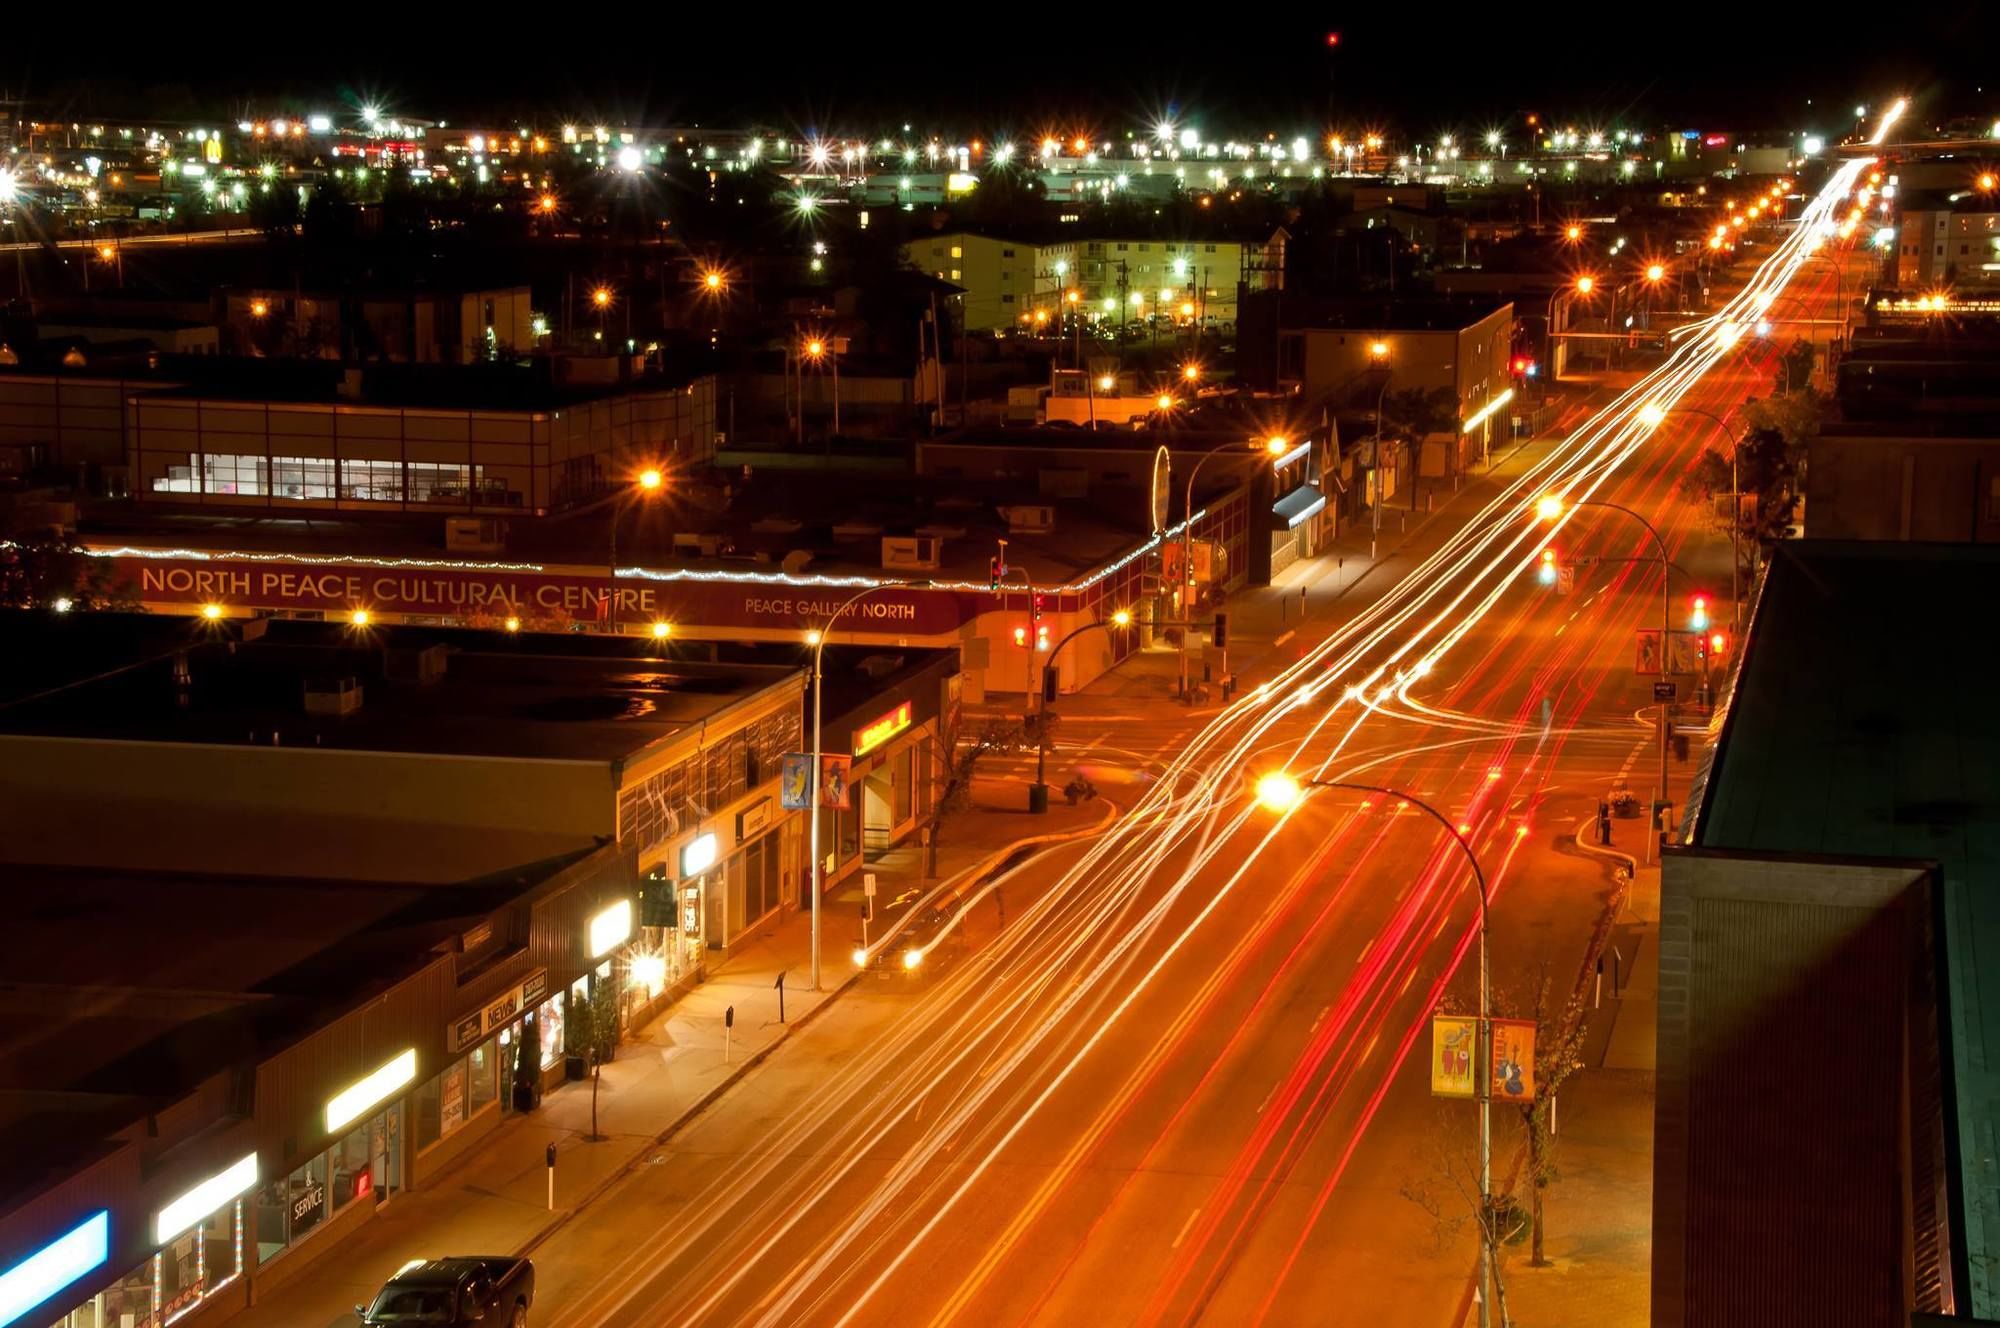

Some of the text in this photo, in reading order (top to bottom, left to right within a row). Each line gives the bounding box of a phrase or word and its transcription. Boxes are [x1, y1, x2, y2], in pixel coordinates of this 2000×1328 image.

[142, 567, 250, 595] NORTH
[262, 572, 361, 599] PEACE
[372, 578, 524, 607] CULTURAL
[745, 599, 915, 619] PEACE GALLERY NORTH
[294, 1187, 323, 1220] SERVICE
